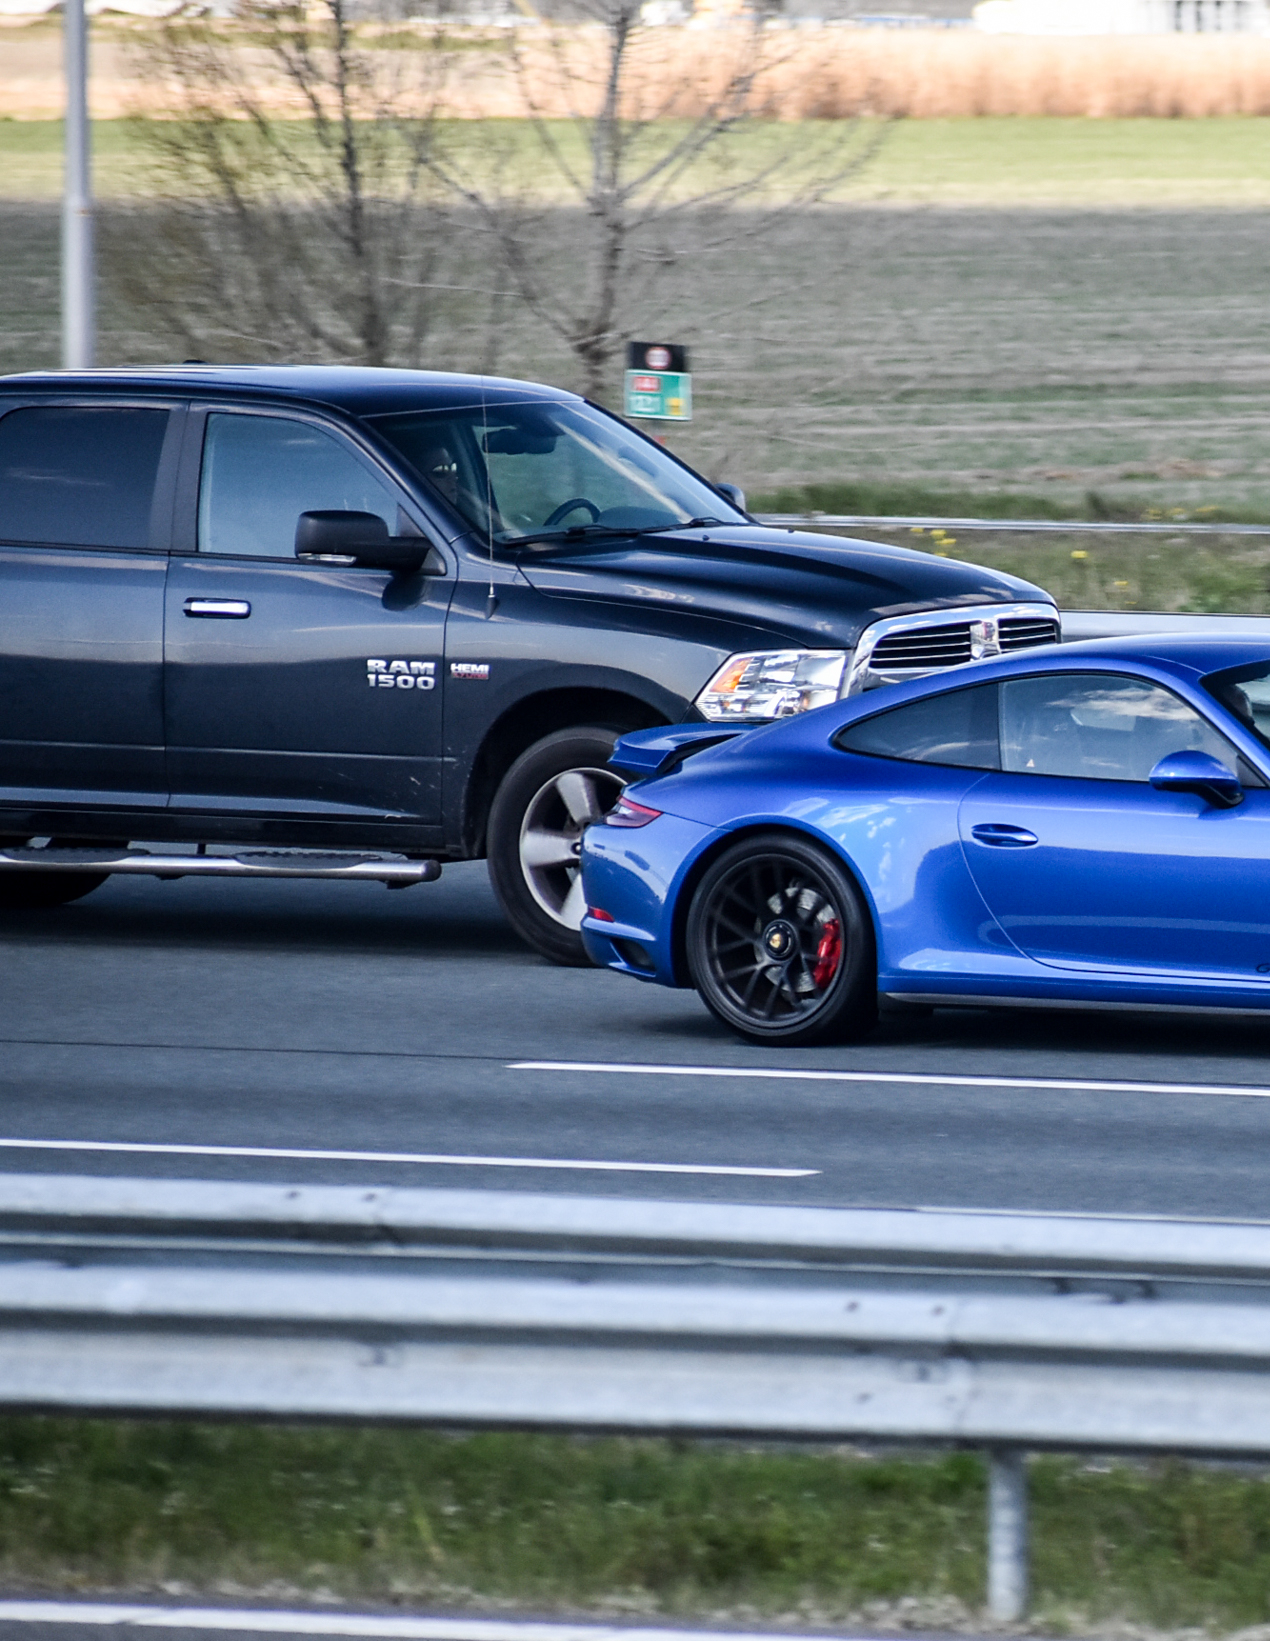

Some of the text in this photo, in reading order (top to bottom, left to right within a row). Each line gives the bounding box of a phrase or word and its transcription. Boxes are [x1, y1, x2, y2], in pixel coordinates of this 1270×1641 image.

[367, 659, 435, 675] RAM
[450, 663, 490, 673] HEMI
[367, 674, 435, 690] 1500
